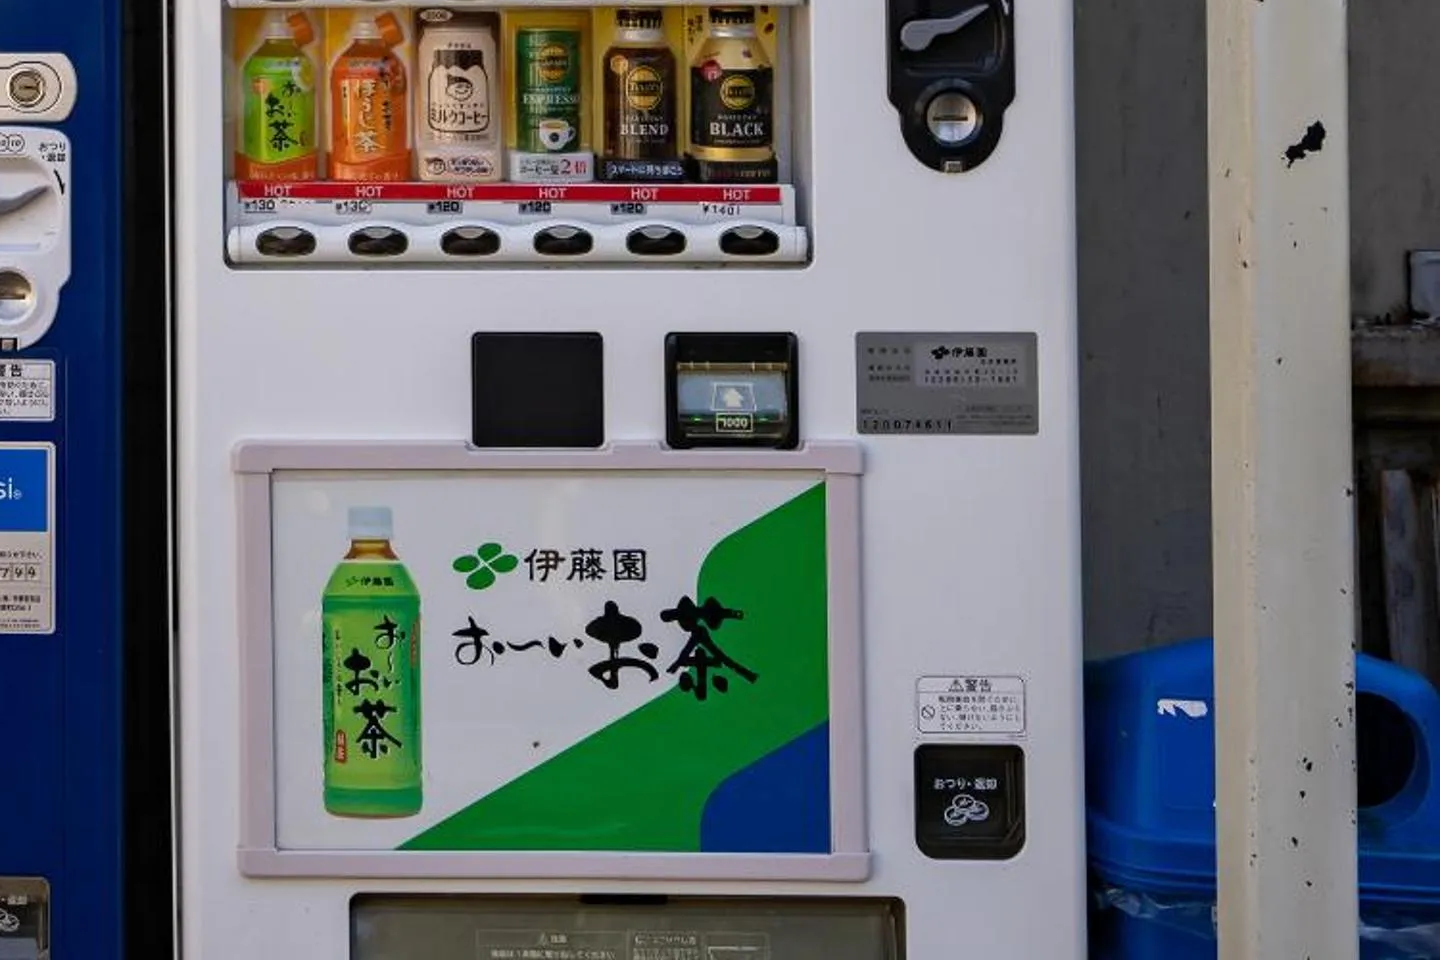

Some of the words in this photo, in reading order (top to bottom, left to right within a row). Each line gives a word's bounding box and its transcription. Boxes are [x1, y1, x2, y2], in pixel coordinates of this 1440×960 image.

[264, 93, 298, 153] お茶
[430, 110, 489, 126] ミルクコーヒー
[620, 124, 669, 136] BLEND
[710, 122, 764, 137] BLACK
[264, 185, 293, 198] HOT
[356, 185, 384, 198] HOT
[447, 187, 475, 199] HOT
[539, 187, 568, 199] HOT
[631, 188, 659, 201] HOT
[723, 189, 751, 201] HOT
[951, 346, 988, 359] 伊藤園
[524, 547, 647, 583] 伊藤園
[359, 576, 395, 588] 伊藤園
[965, 679, 993, 692] 警告
[343, 647, 403, 760] お茶
